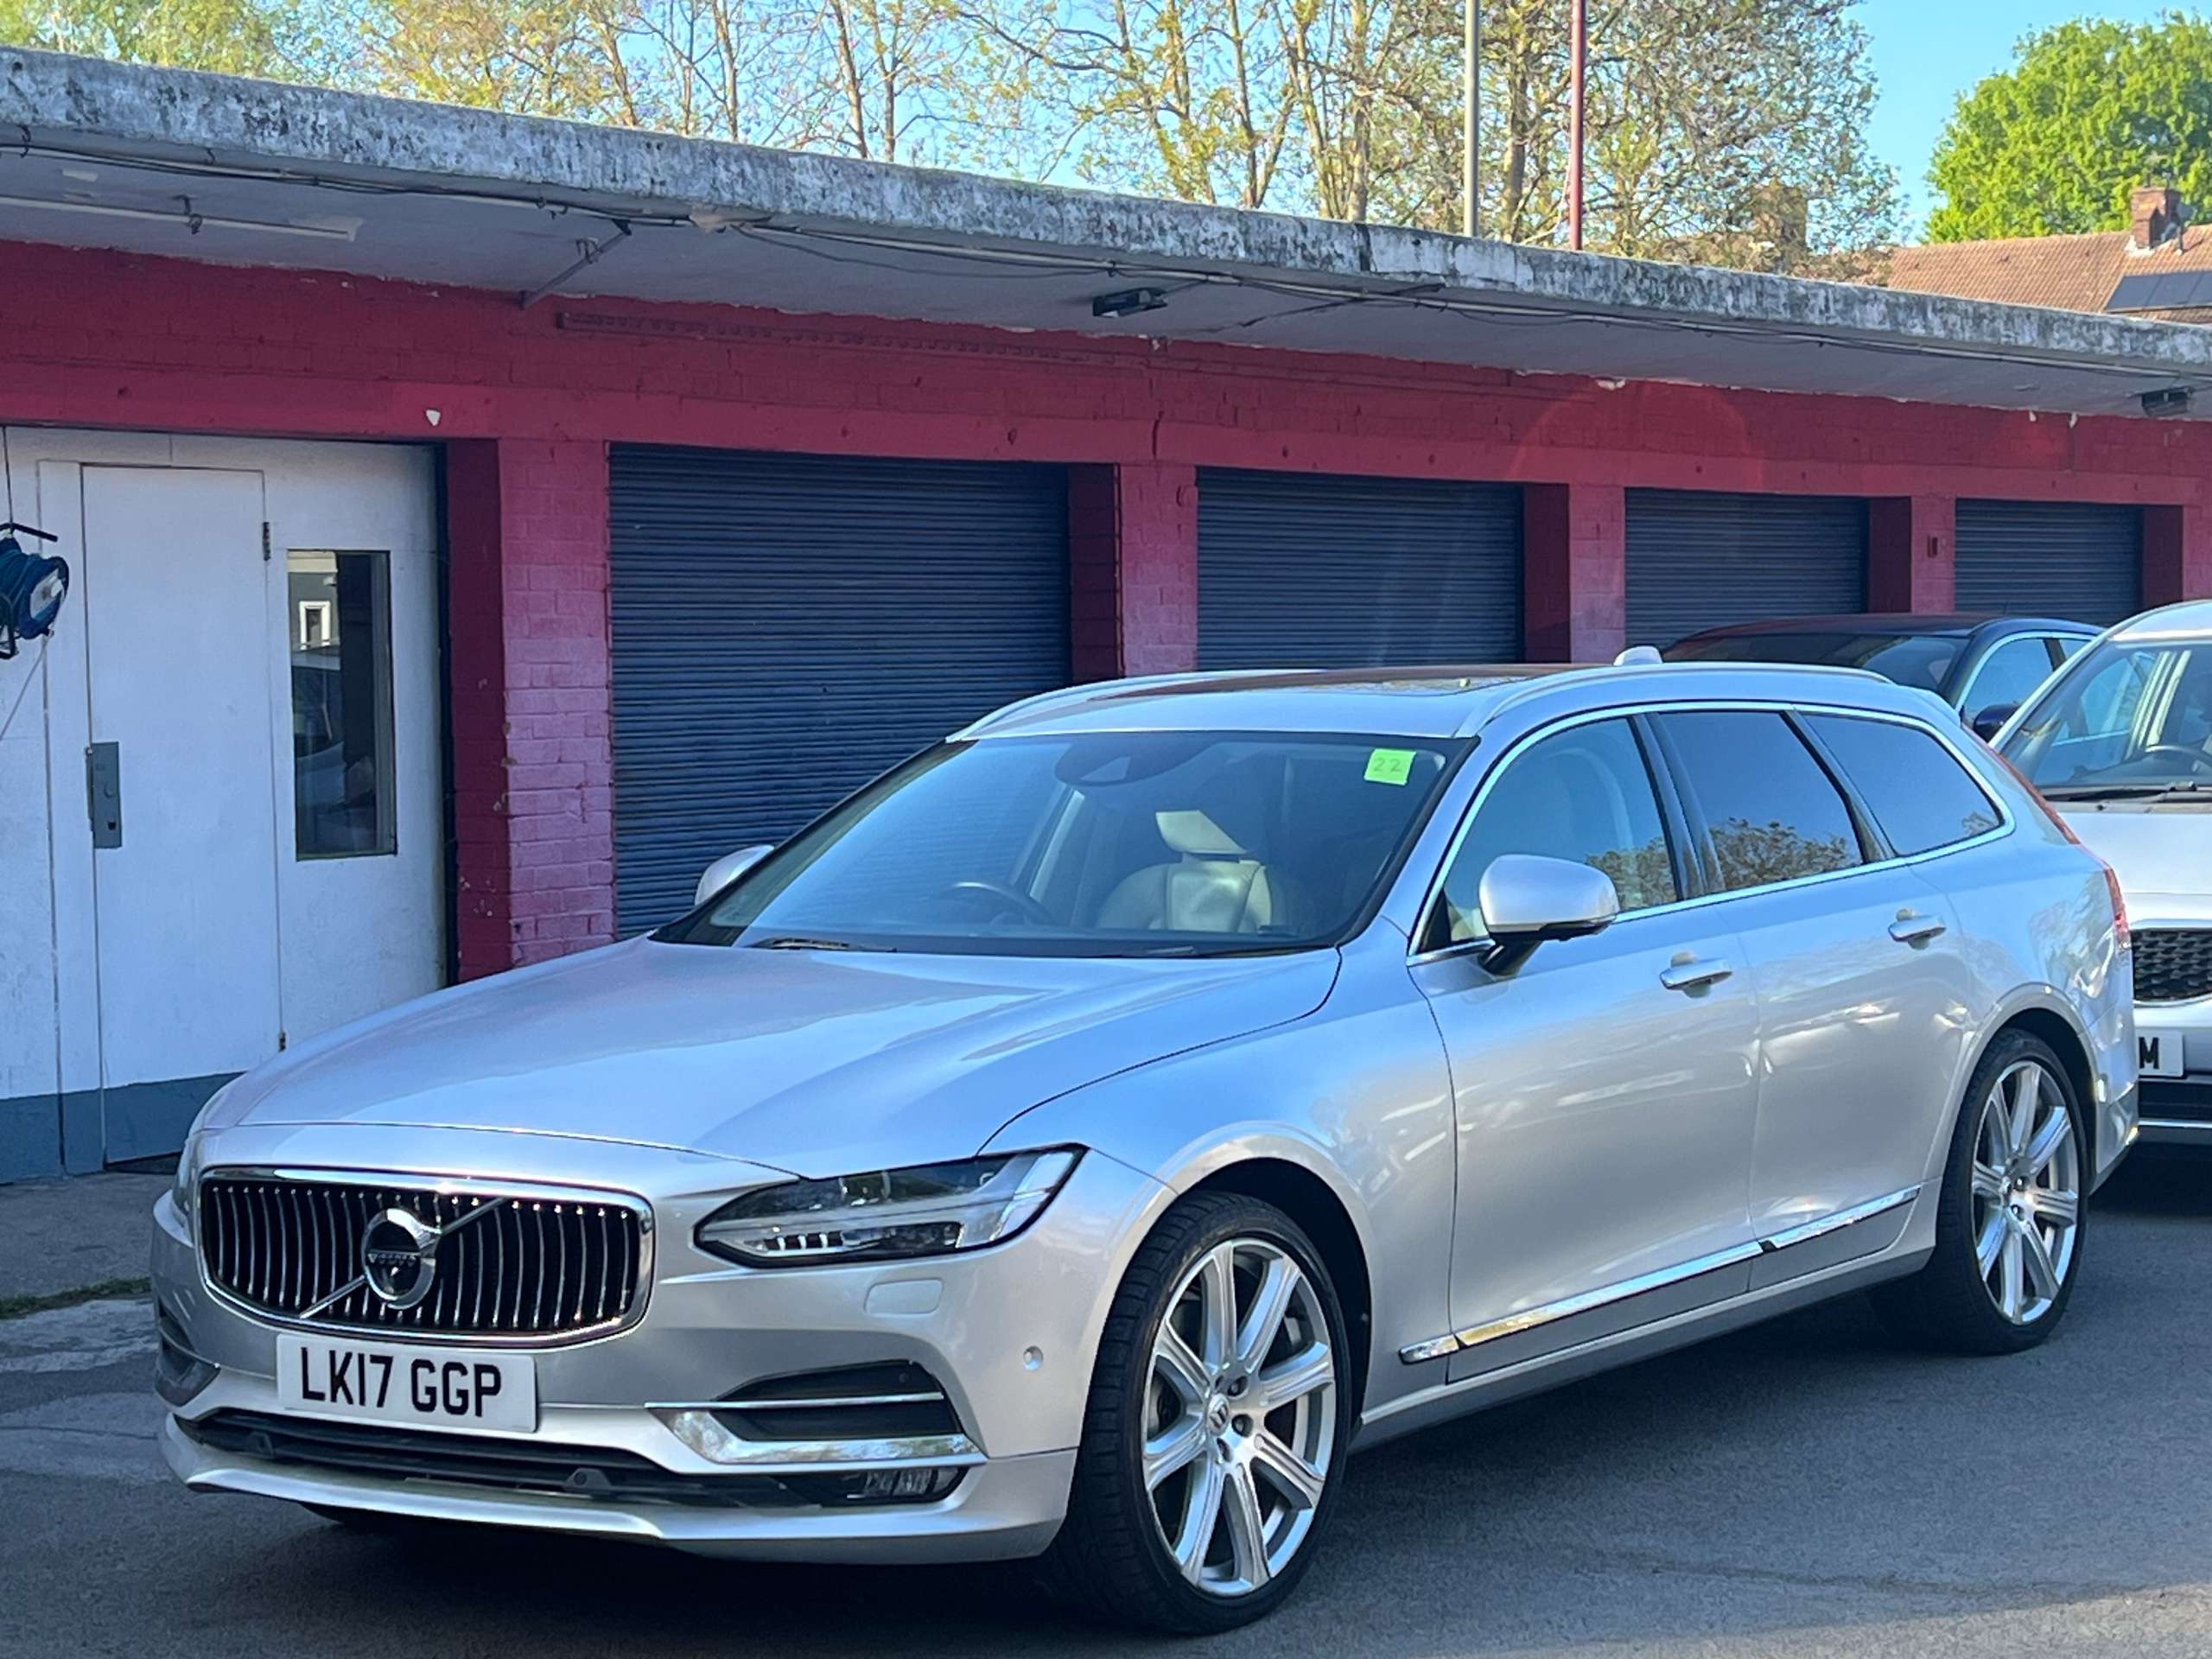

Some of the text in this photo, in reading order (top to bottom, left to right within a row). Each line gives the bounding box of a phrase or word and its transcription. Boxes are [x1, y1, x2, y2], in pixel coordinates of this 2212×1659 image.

[2139, 1036, 2159, 1070] M
[301, 1347, 502, 1417] LK17 GGP
